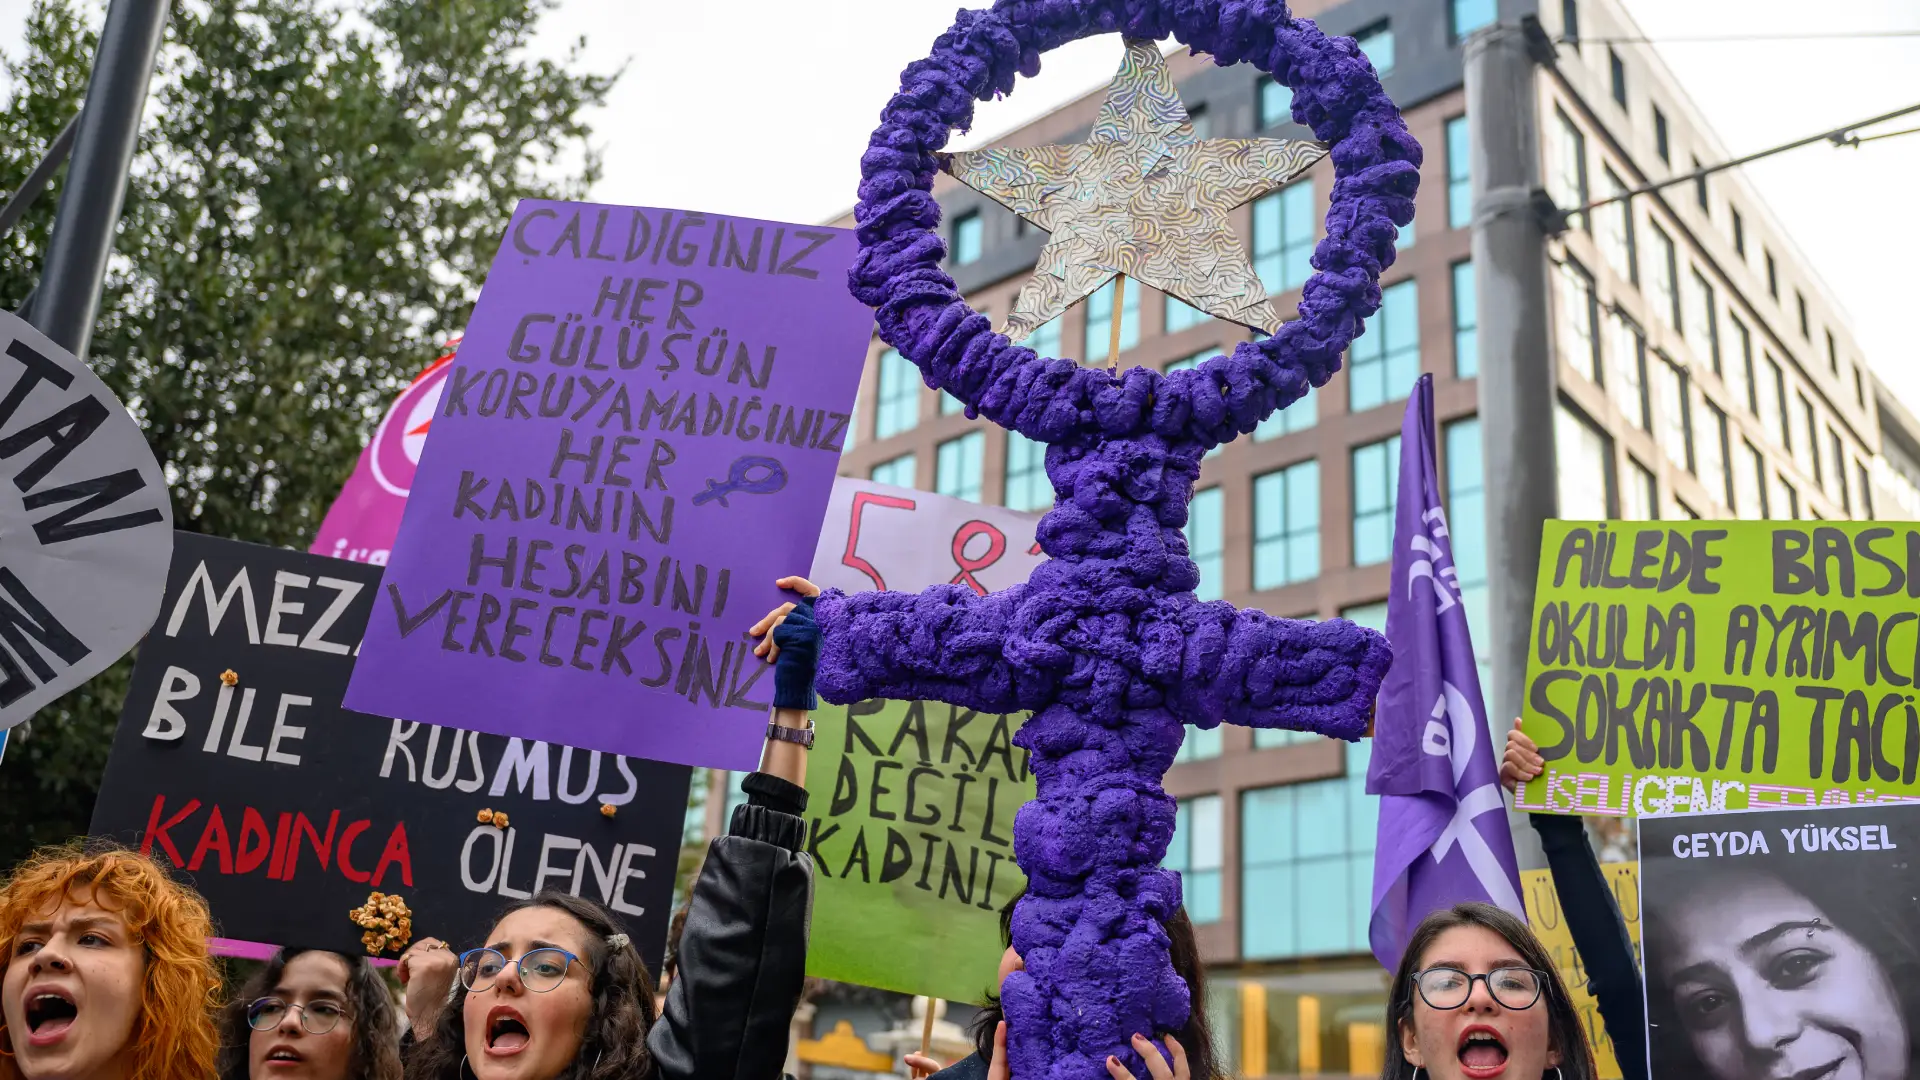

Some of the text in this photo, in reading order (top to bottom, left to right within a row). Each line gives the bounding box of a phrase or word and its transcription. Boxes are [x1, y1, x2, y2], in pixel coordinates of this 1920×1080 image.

[512, 207, 836, 280] ÇALDIĞINIZ
[591, 275, 704, 331] HER
[507, 312, 777, 390] GÜLÜŞÜN
[443, 365, 851, 453] KORUYAMADIĞINIZ
[549, 427, 677, 491] HER
[452, 470, 676, 544] KADININ
[465, 533, 731, 618] HESABINI
[1553, 523, 1728, 594] AİLEDE
[165, 559, 364, 656] MEZ
[1537, 601, 1696, 673] OKULDA
[142, 665, 312, 766] BİLE
[843, 699, 1031, 783] RAKA
[1529, 669, 1780, 775] SOKAKTA
[139, 794, 413, 887] KADINCA
[828, 753, 1010, 847] DEĞİL
[1672, 824, 1897, 859] CEYDA YÜKSEL
[808, 816, 1018, 914] KADINI
